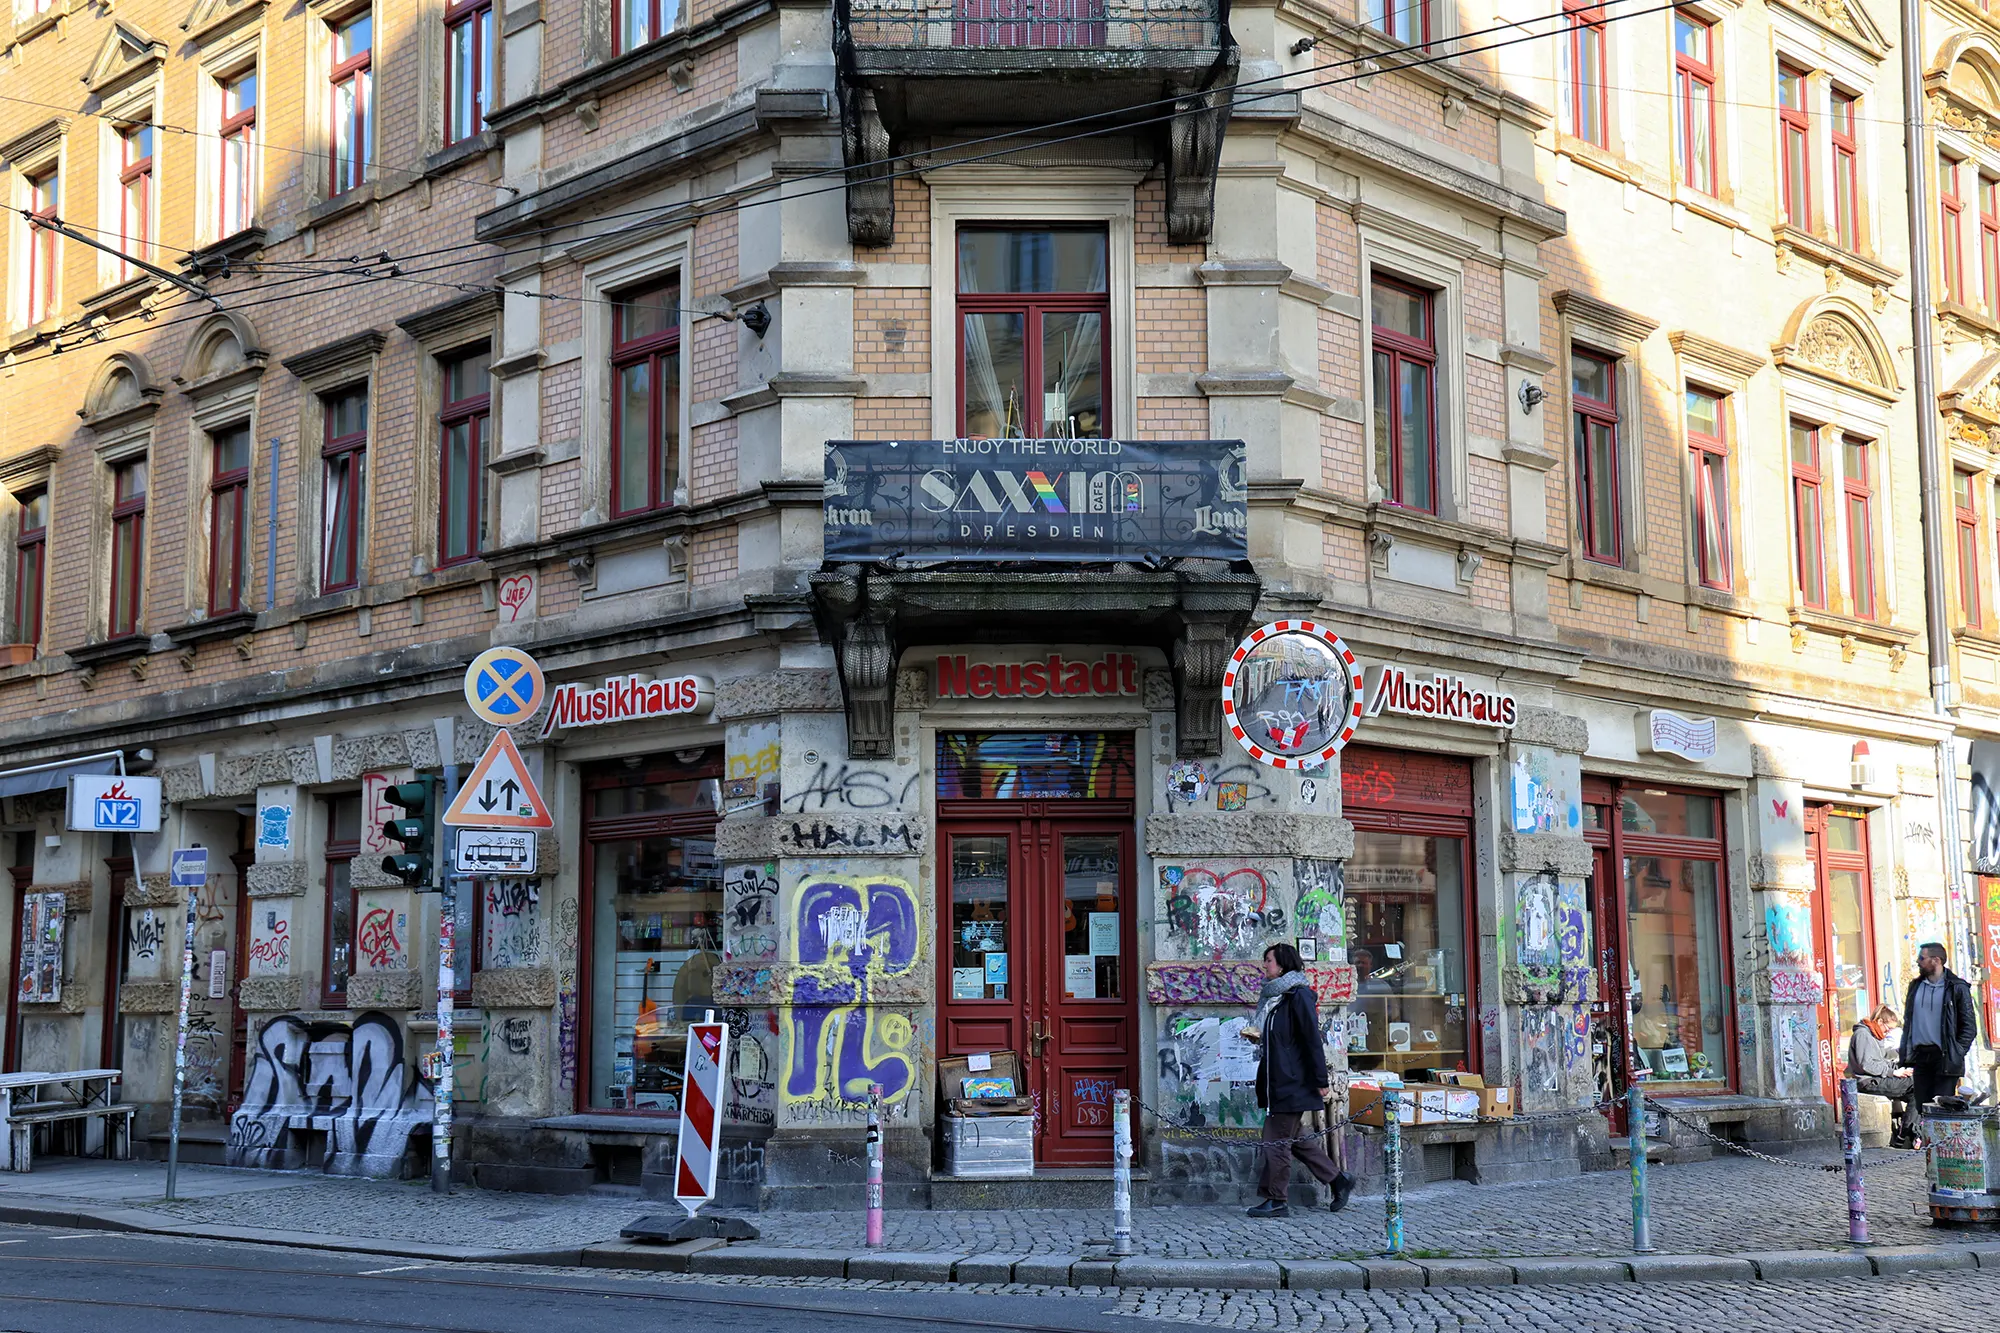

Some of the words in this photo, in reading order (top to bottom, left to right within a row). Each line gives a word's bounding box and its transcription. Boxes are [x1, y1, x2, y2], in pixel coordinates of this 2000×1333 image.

[942, 440, 1006, 455] ENJOY
[1009, 440, 1046, 455] THE
[1052, 440, 1122, 455] WORLD
[1093, 481, 1104, 512] CAFE
[1126, 483, 1139, 512] BAR
[960, 525, 1105, 538] DRESDEN
[936, 653, 1138, 698] Neustadt
[541, 674, 701, 739] Musikhaus
[1368, 666, 1517, 729] Musikhaus
[724, 1106, 775, 1127] ANARCHISM
